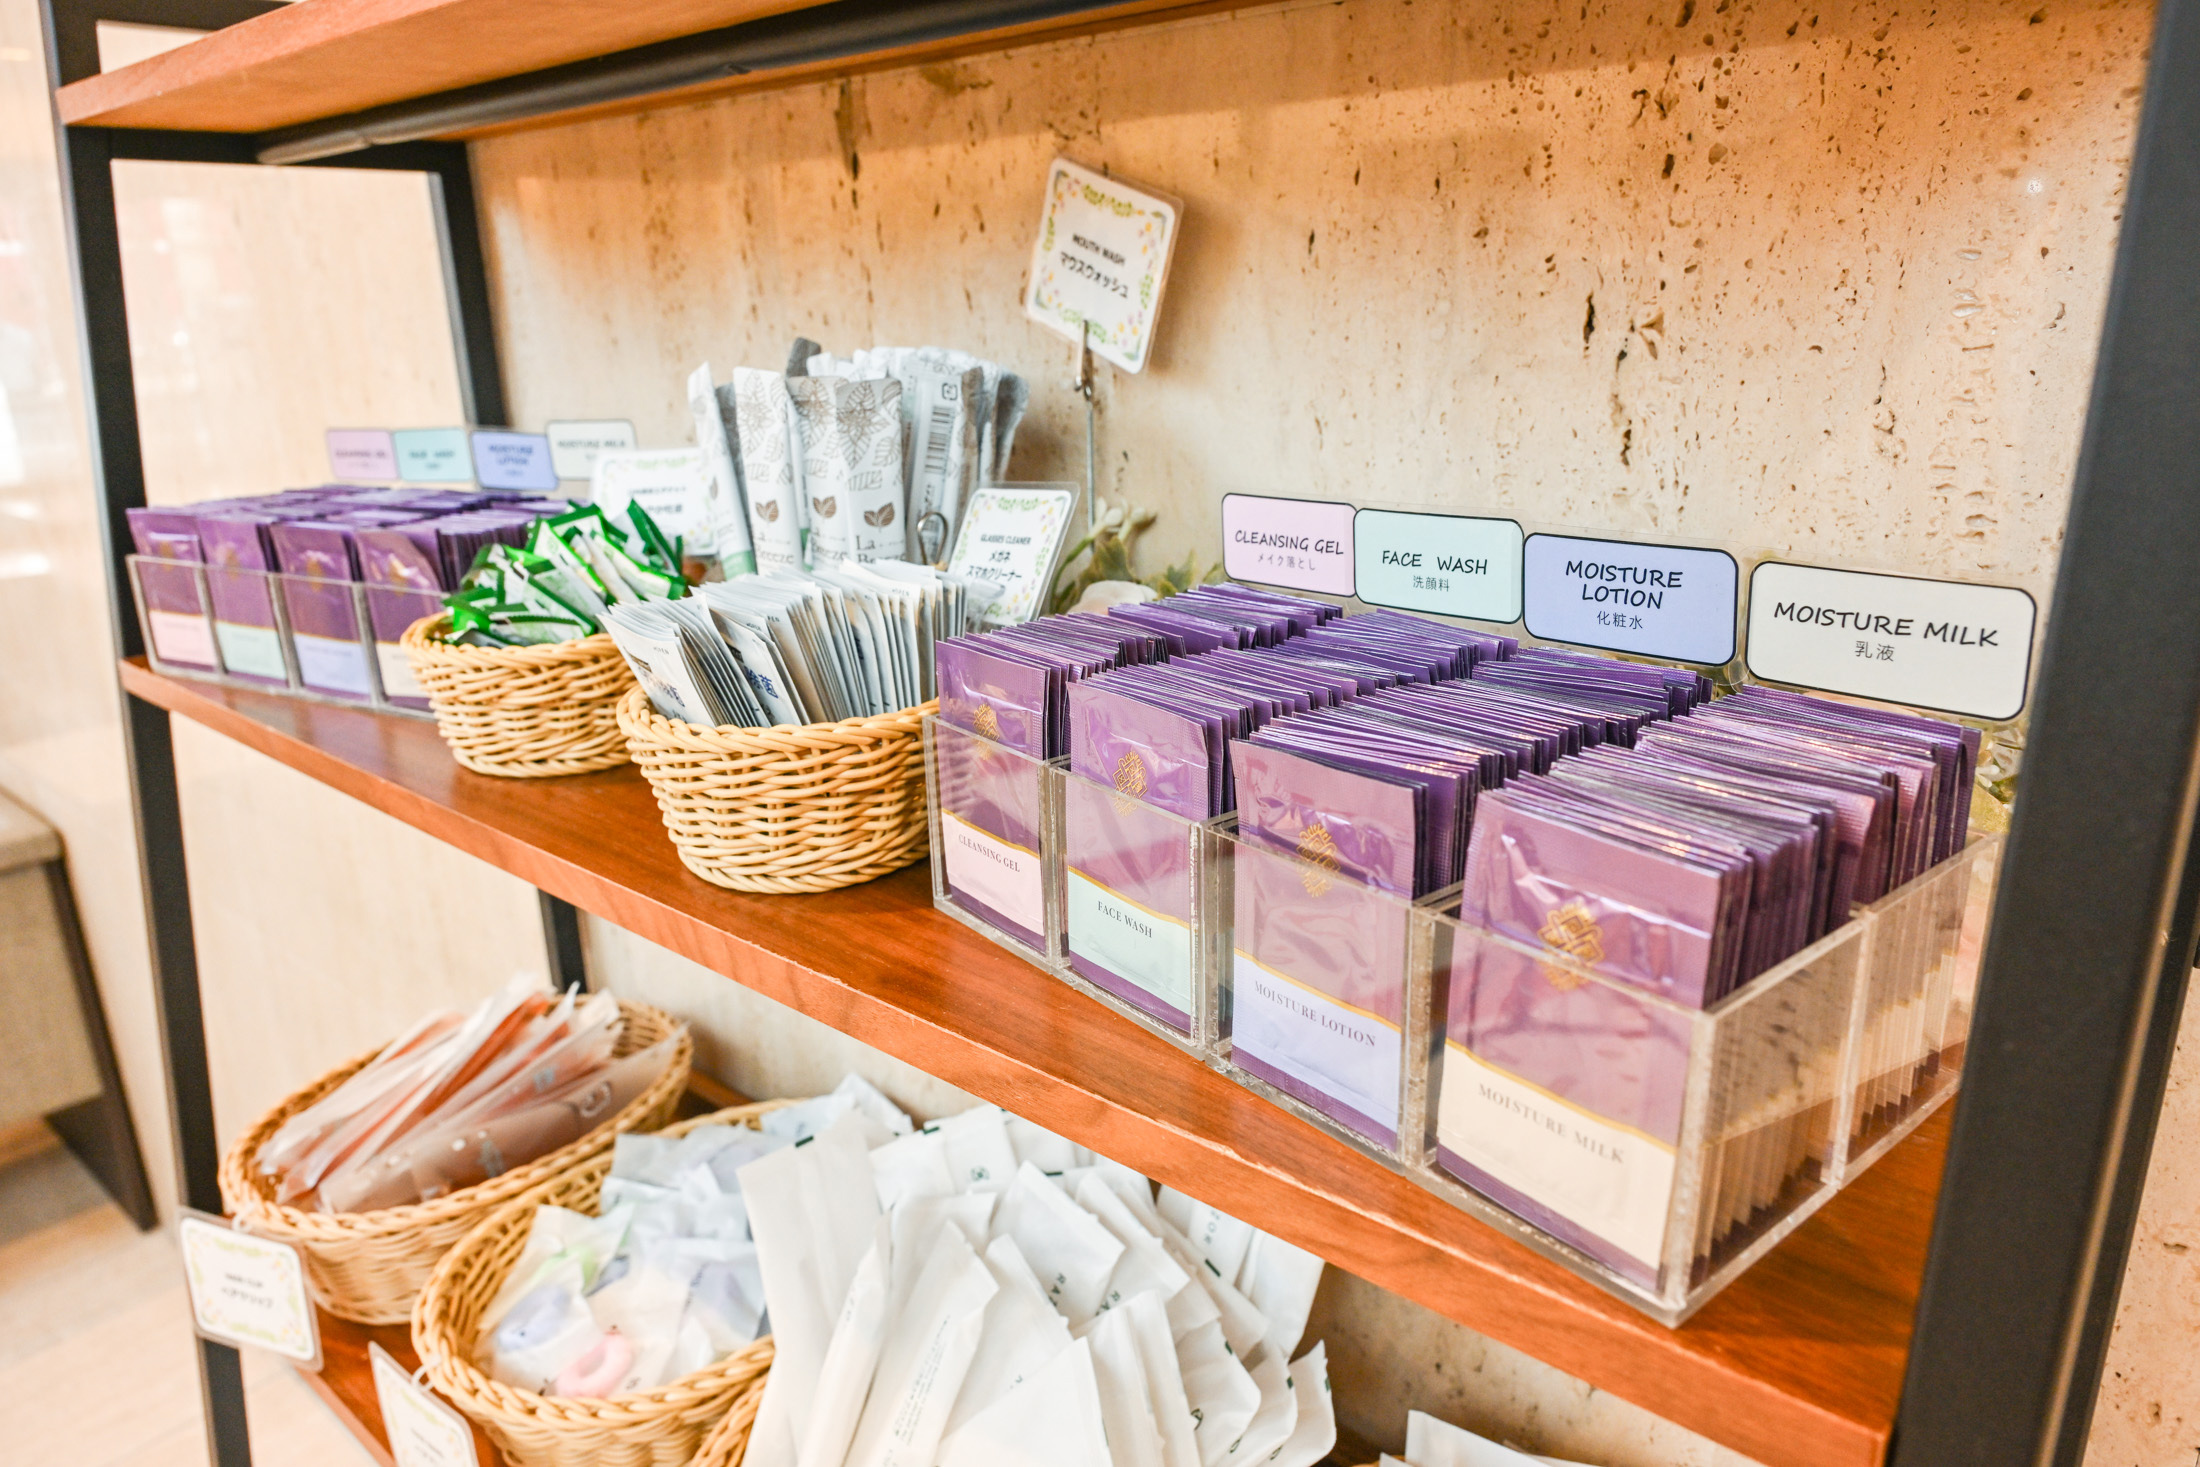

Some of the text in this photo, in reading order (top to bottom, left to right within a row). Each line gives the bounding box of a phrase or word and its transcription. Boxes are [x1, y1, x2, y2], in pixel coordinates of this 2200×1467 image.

[1072, 233, 1126, 266] MOUTH WASH
[1060, 251, 1129, 299] マウスウォッシュ
[855, 535, 876, 551] La
[980, 533, 1031, 545] GLASSES CLEANER
[1235, 530, 1344, 556] CLEANSING GEL
[989, 551, 1011, 562] メガネ
[1257, 552, 1316, 571] メイク落とし
[1382, 550, 1488, 575] FACE WASH
[966, 565, 1022, 581] スマホクリーナー
[1412, 575, 1450, 593] 洗顔料
[1565, 560, 1683, 589] MOISTURE
[1581, 585, 1664, 609] LOTION
[1596, 610, 1644, 631] 化粧水
[1774, 601, 2000, 648] MOISTURE MILK
[1854, 640, 1895, 663] 乳液
[958, 834, 1021, 873] CLEANSING GEL
[1098, 900, 1153, 938] FACE WASH
[1255, 980, 1376, 1046] MOISTURE LOTION
[1478, 1083, 1624, 1164] MOISTURE MILK
